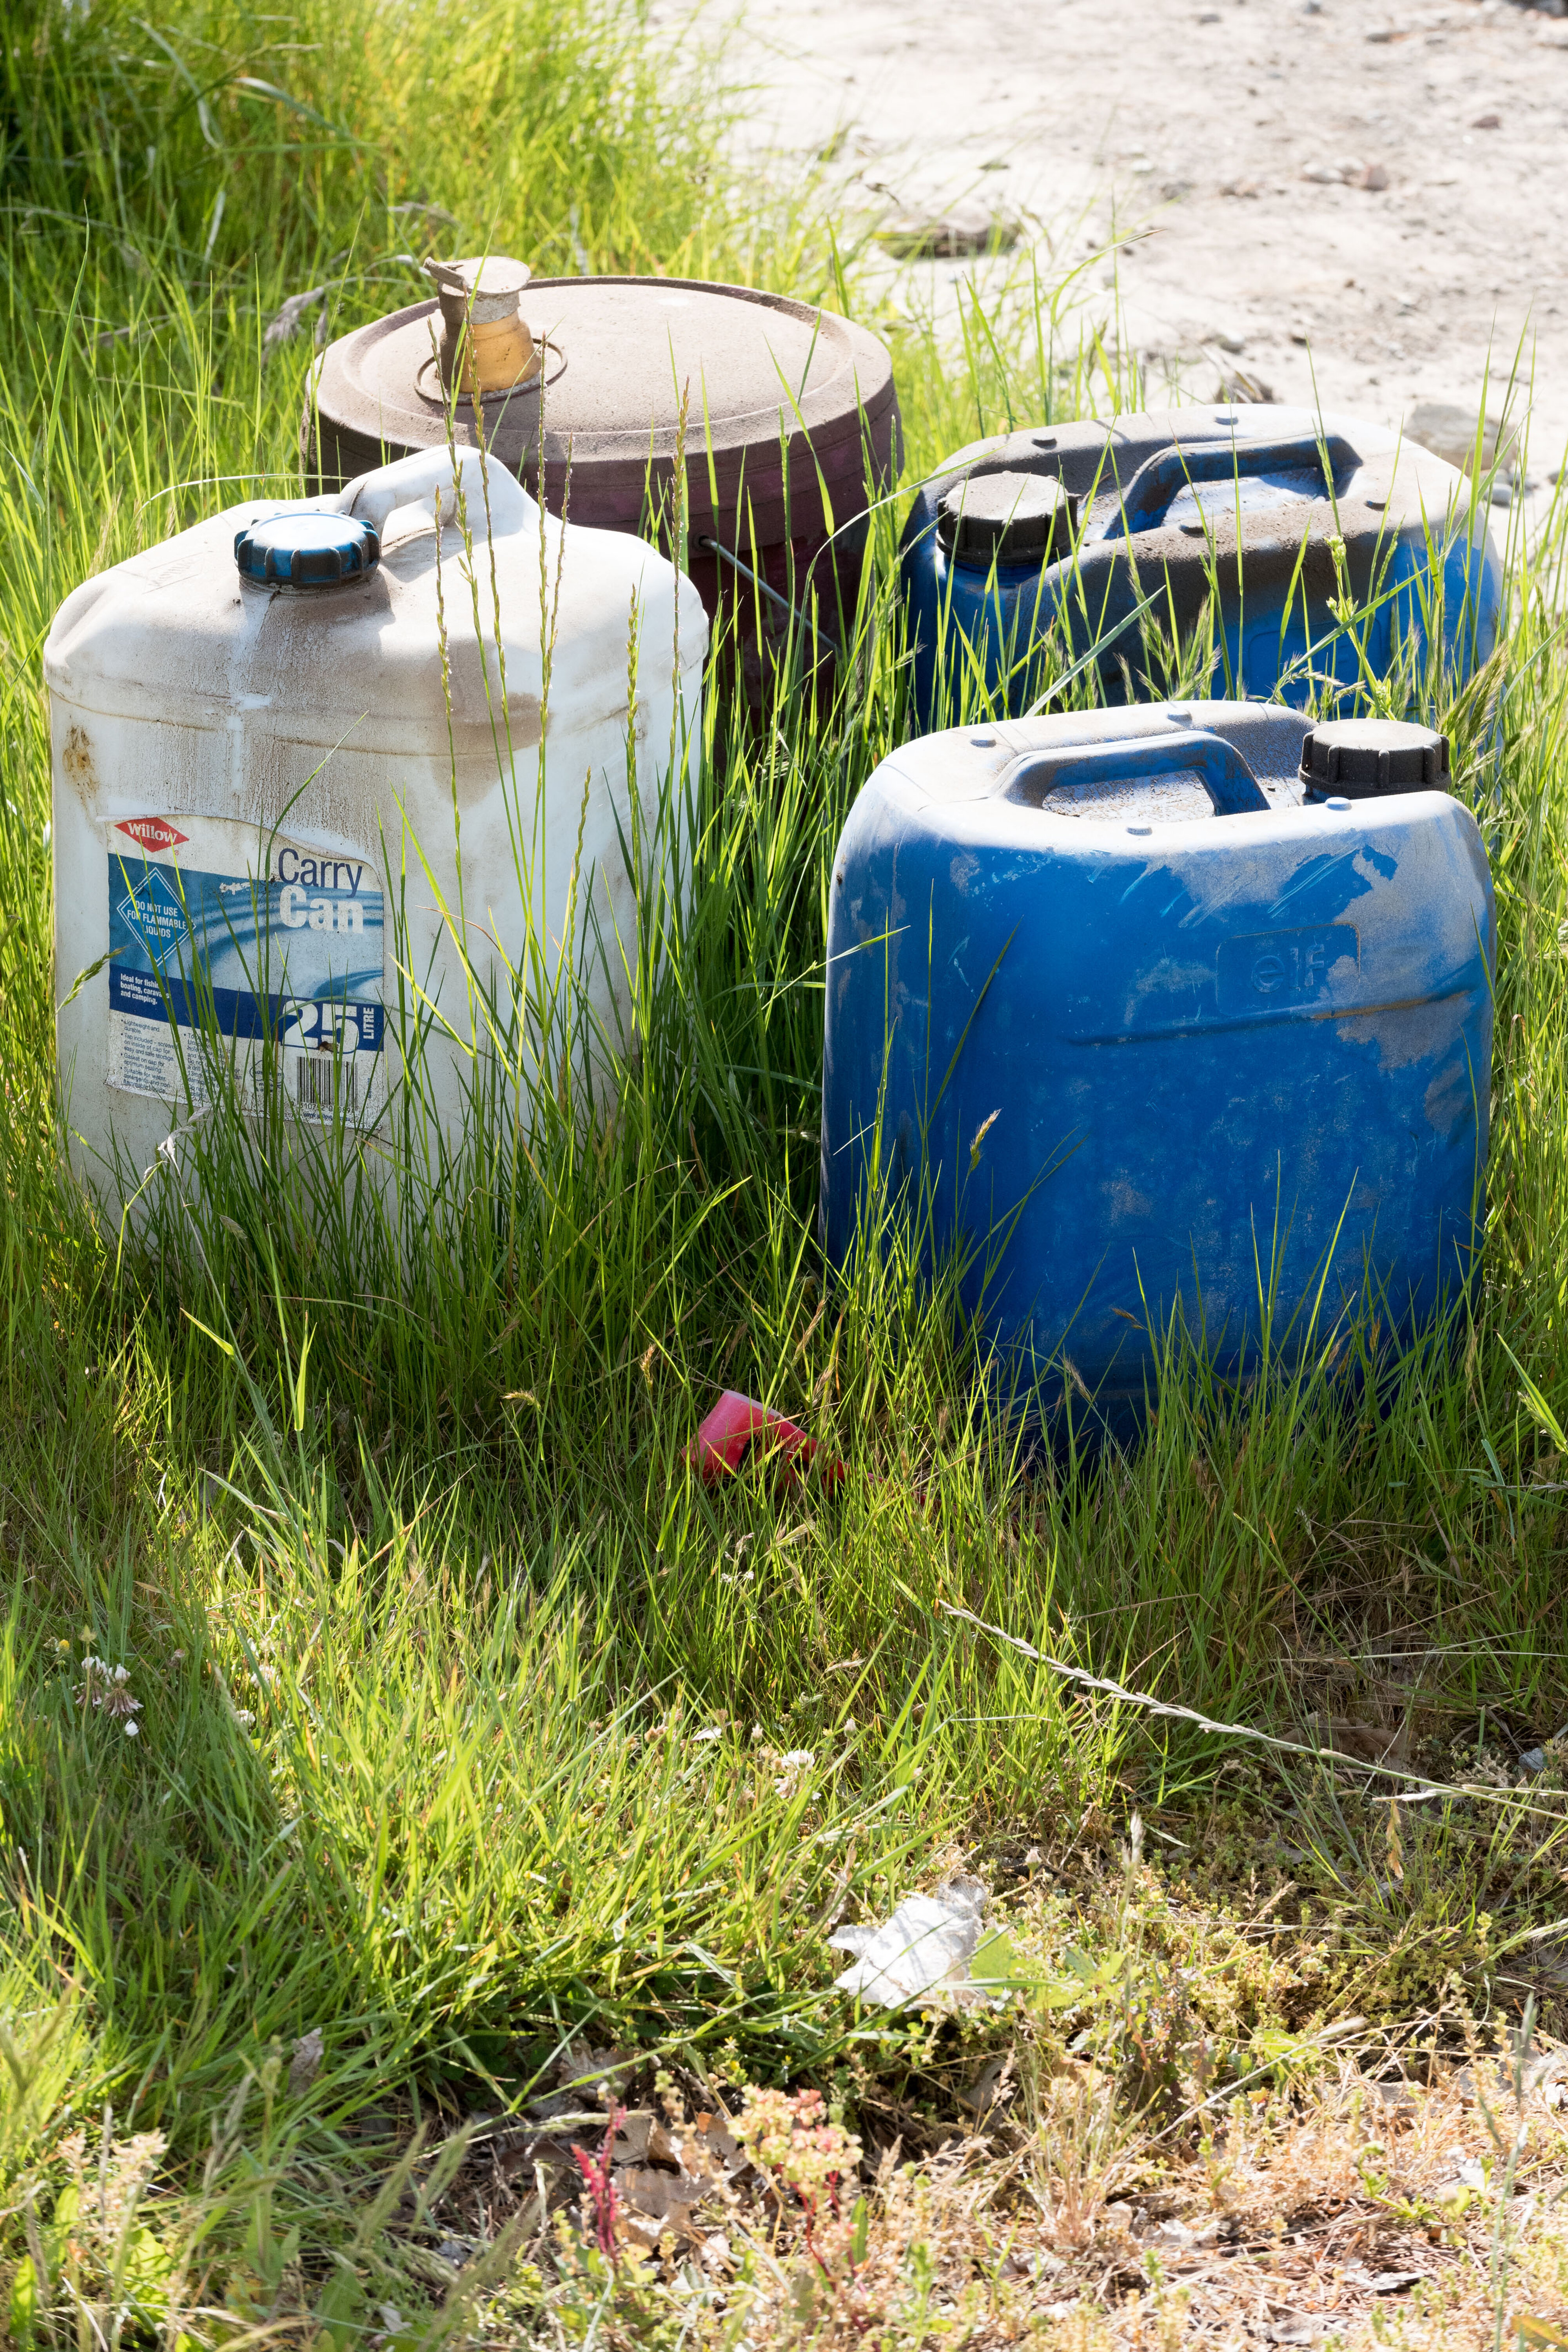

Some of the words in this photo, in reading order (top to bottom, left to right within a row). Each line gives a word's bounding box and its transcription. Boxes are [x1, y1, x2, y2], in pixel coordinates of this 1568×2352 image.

[127, 822, 178, 843] Willow
[278, 848, 362, 898] Carry
[135, 900, 145, 910] DO
[147, 903, 162, 914] NOT
[163, 906, 178, 916] USE
[279, 885, 363, 933] Can
[127, 909, 141, 920] FOR
[143, 913, 186, 930] FLAMMABLE
[143, 924, 171, 938] LIQUIDS
[121, 973, 134, 983] Ideal
[144, 979, 165, 990] fishin,
[120, 981, 142, 994] boating,
[143, 988, 169, 998] caravas
[132, 994, 157, 1005] camping.
[124, 1020, 150, 1030] Lightweight
[282, 1000, 359, 1053] 25
[363, 1007, 374, 1039] LITRE
[134, 1036, 152, 1044] included
[124, 1053, 140, 1061] Gasket
[124, 1060, 143, 1068] optimum
[145, 1065, 162, 1073] sealing.
[124, 1067, 142, 1076] Suitable
[188, 1077, 204, 1085] damag
[300, 1102, 325, 1111] 31072
